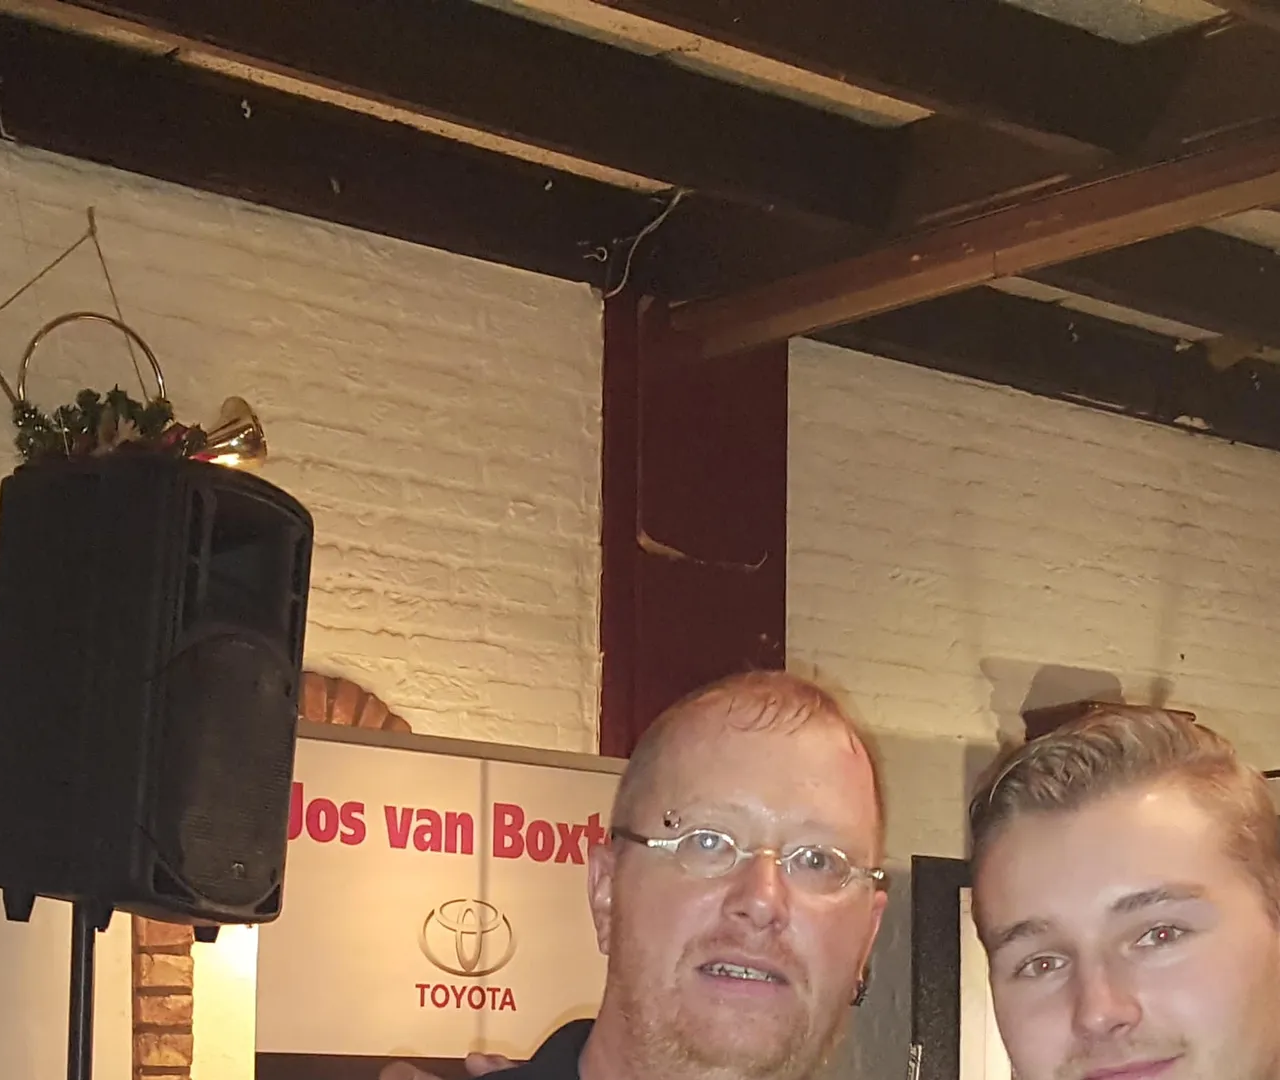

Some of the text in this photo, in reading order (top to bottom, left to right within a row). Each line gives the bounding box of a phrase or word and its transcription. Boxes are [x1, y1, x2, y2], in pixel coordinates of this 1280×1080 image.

[288, 783, 366, 845] Jos
[383, 806, 474, 855] van
[415, 984, 517, 1012] TOYOTA
